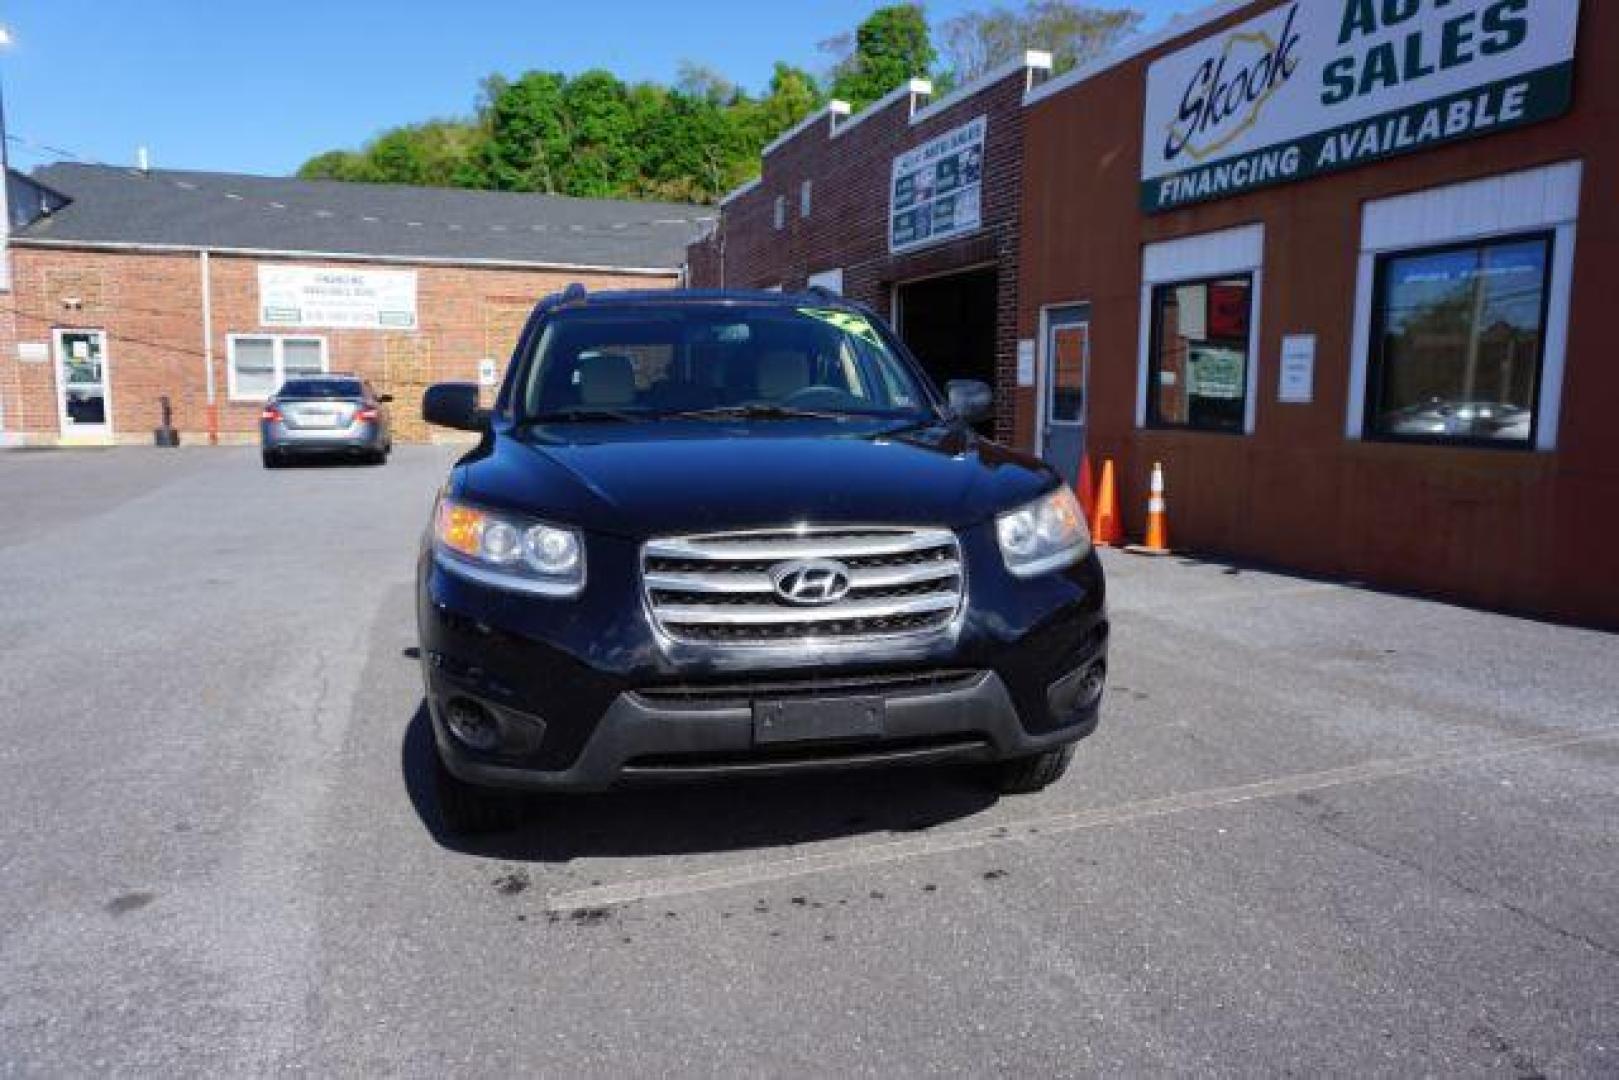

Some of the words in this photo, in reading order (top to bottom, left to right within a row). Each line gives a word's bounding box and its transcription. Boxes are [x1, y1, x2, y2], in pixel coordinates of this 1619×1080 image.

[1320, 0, 1527, 105] SALES
[1338, 0, 1450, 43] AU
[1164, 2, 1299, 160] Skook
[1159, 146, 1300, 205] FINANCING
[1317, 84, 1529, 167] AVAILABLE
